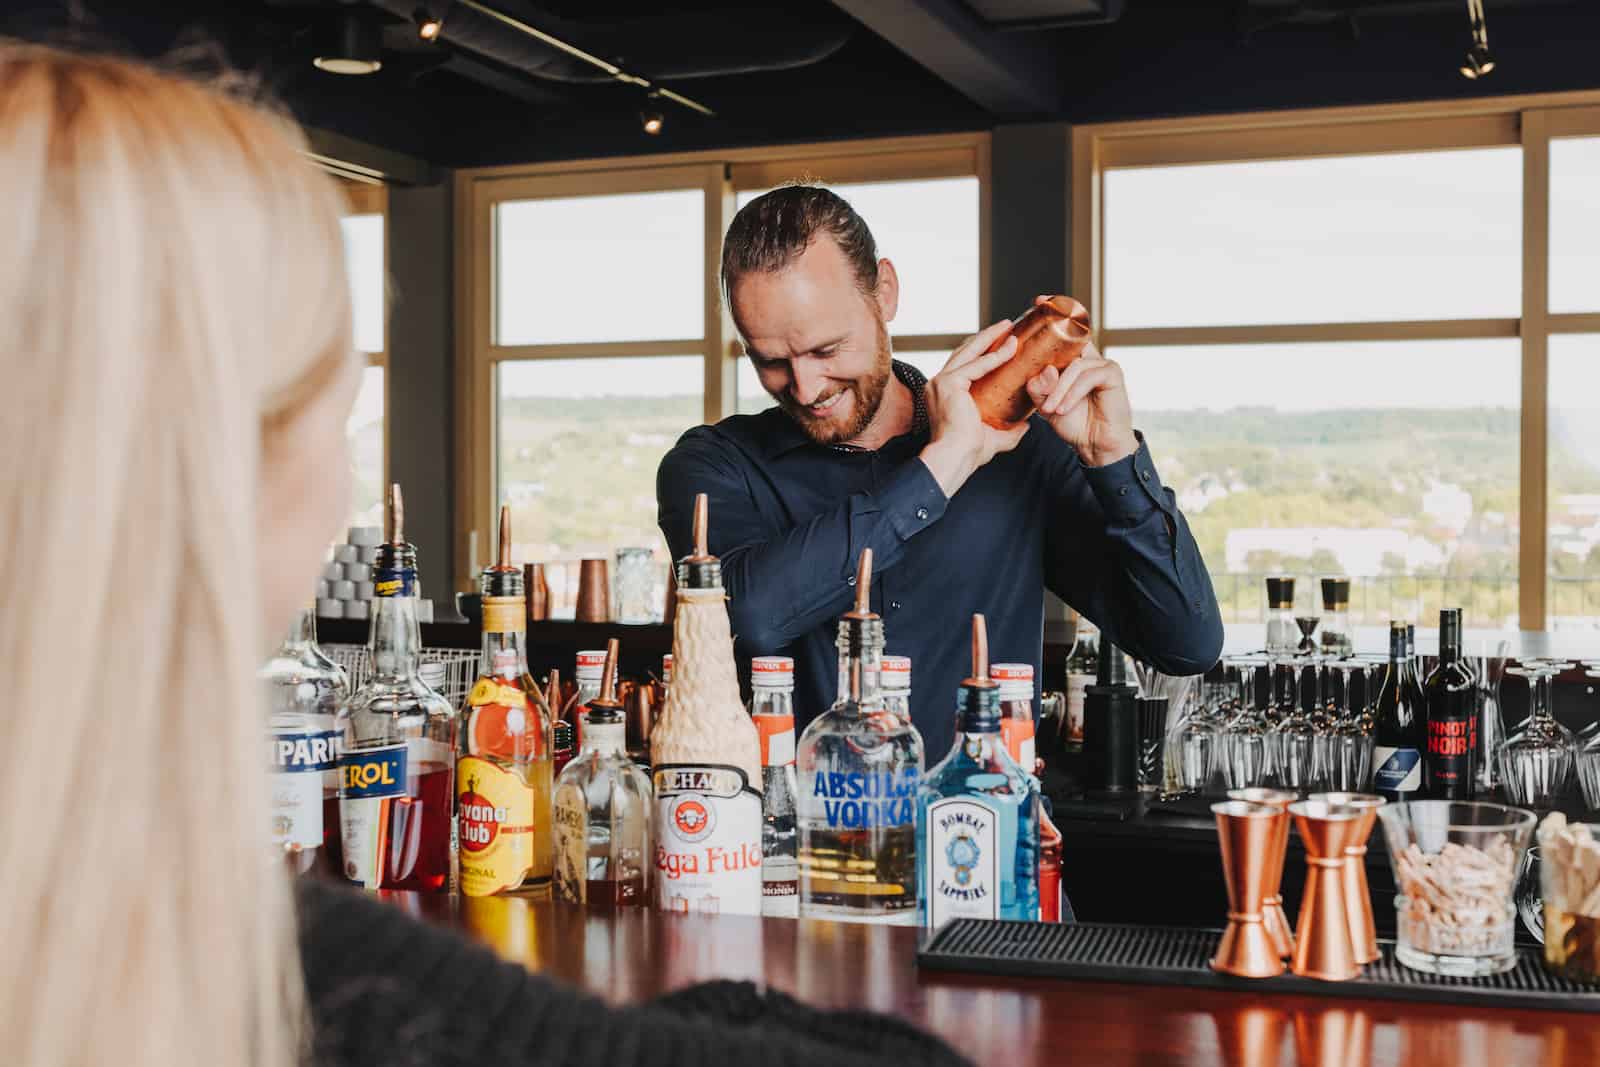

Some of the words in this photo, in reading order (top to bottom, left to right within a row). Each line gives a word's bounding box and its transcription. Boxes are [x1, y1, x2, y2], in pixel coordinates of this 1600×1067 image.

[1428, 720, 1467, 737] PINOT
[1428, 737, 1467, 755] NOIR
[824, 800, 913, 828] VODKA
[940, 812, 985, 833] BOMBAY
[938, 880, 987, 900] SAPPHIRE
